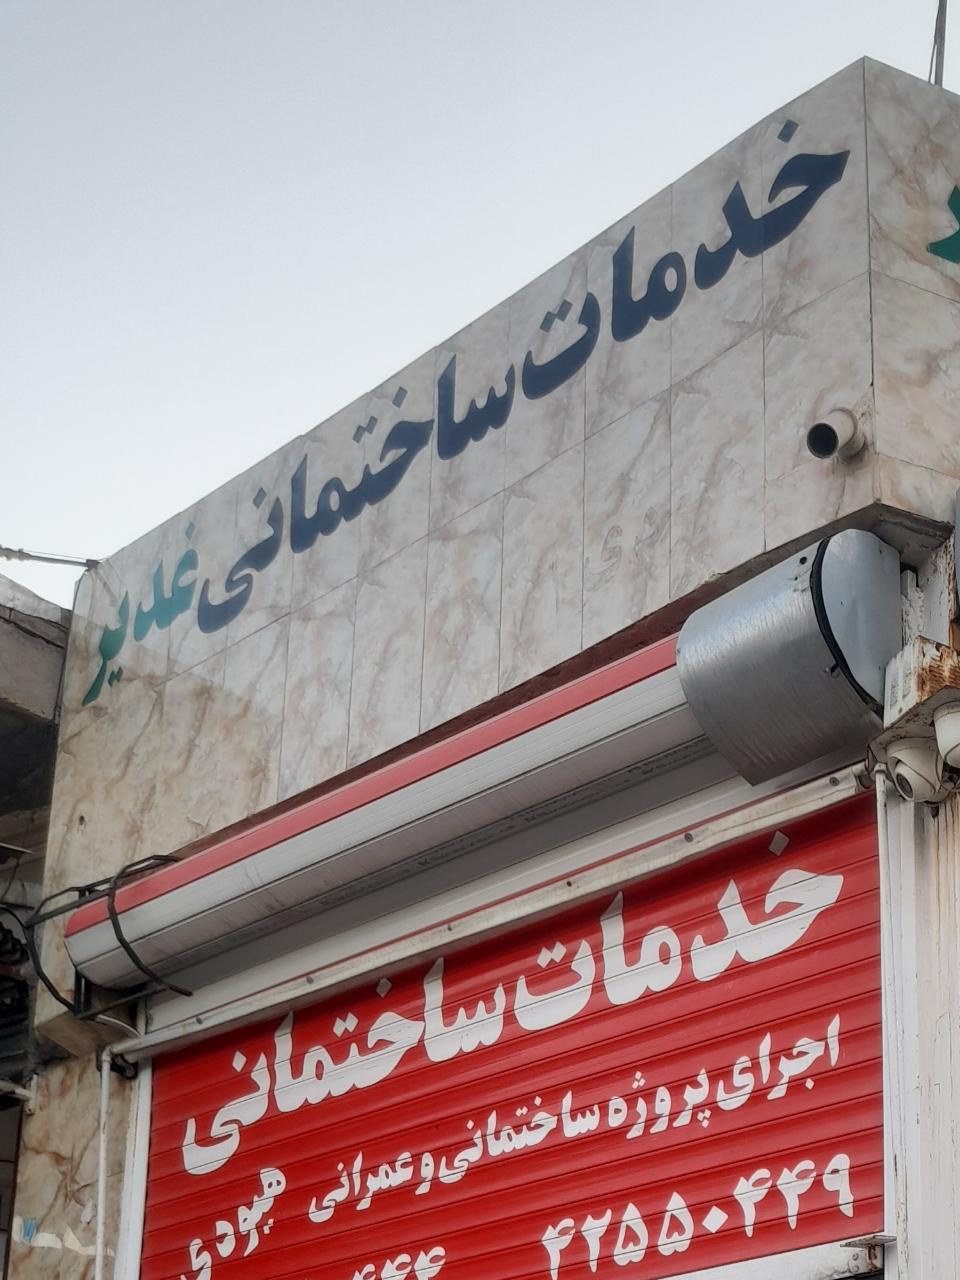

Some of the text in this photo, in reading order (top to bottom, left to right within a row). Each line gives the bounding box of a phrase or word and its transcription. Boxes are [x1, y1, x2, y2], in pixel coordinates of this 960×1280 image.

[82, 119, 851, 707] خدمات ساختمانی غدیر
[181, 830, 844, 1176] خدمات ساختمانی
[608, 1070, 711, 1140] پروژه
[715, 1013, 841, 1111] اجرای
[438, 1090, 600, 1184] ساختمانی
